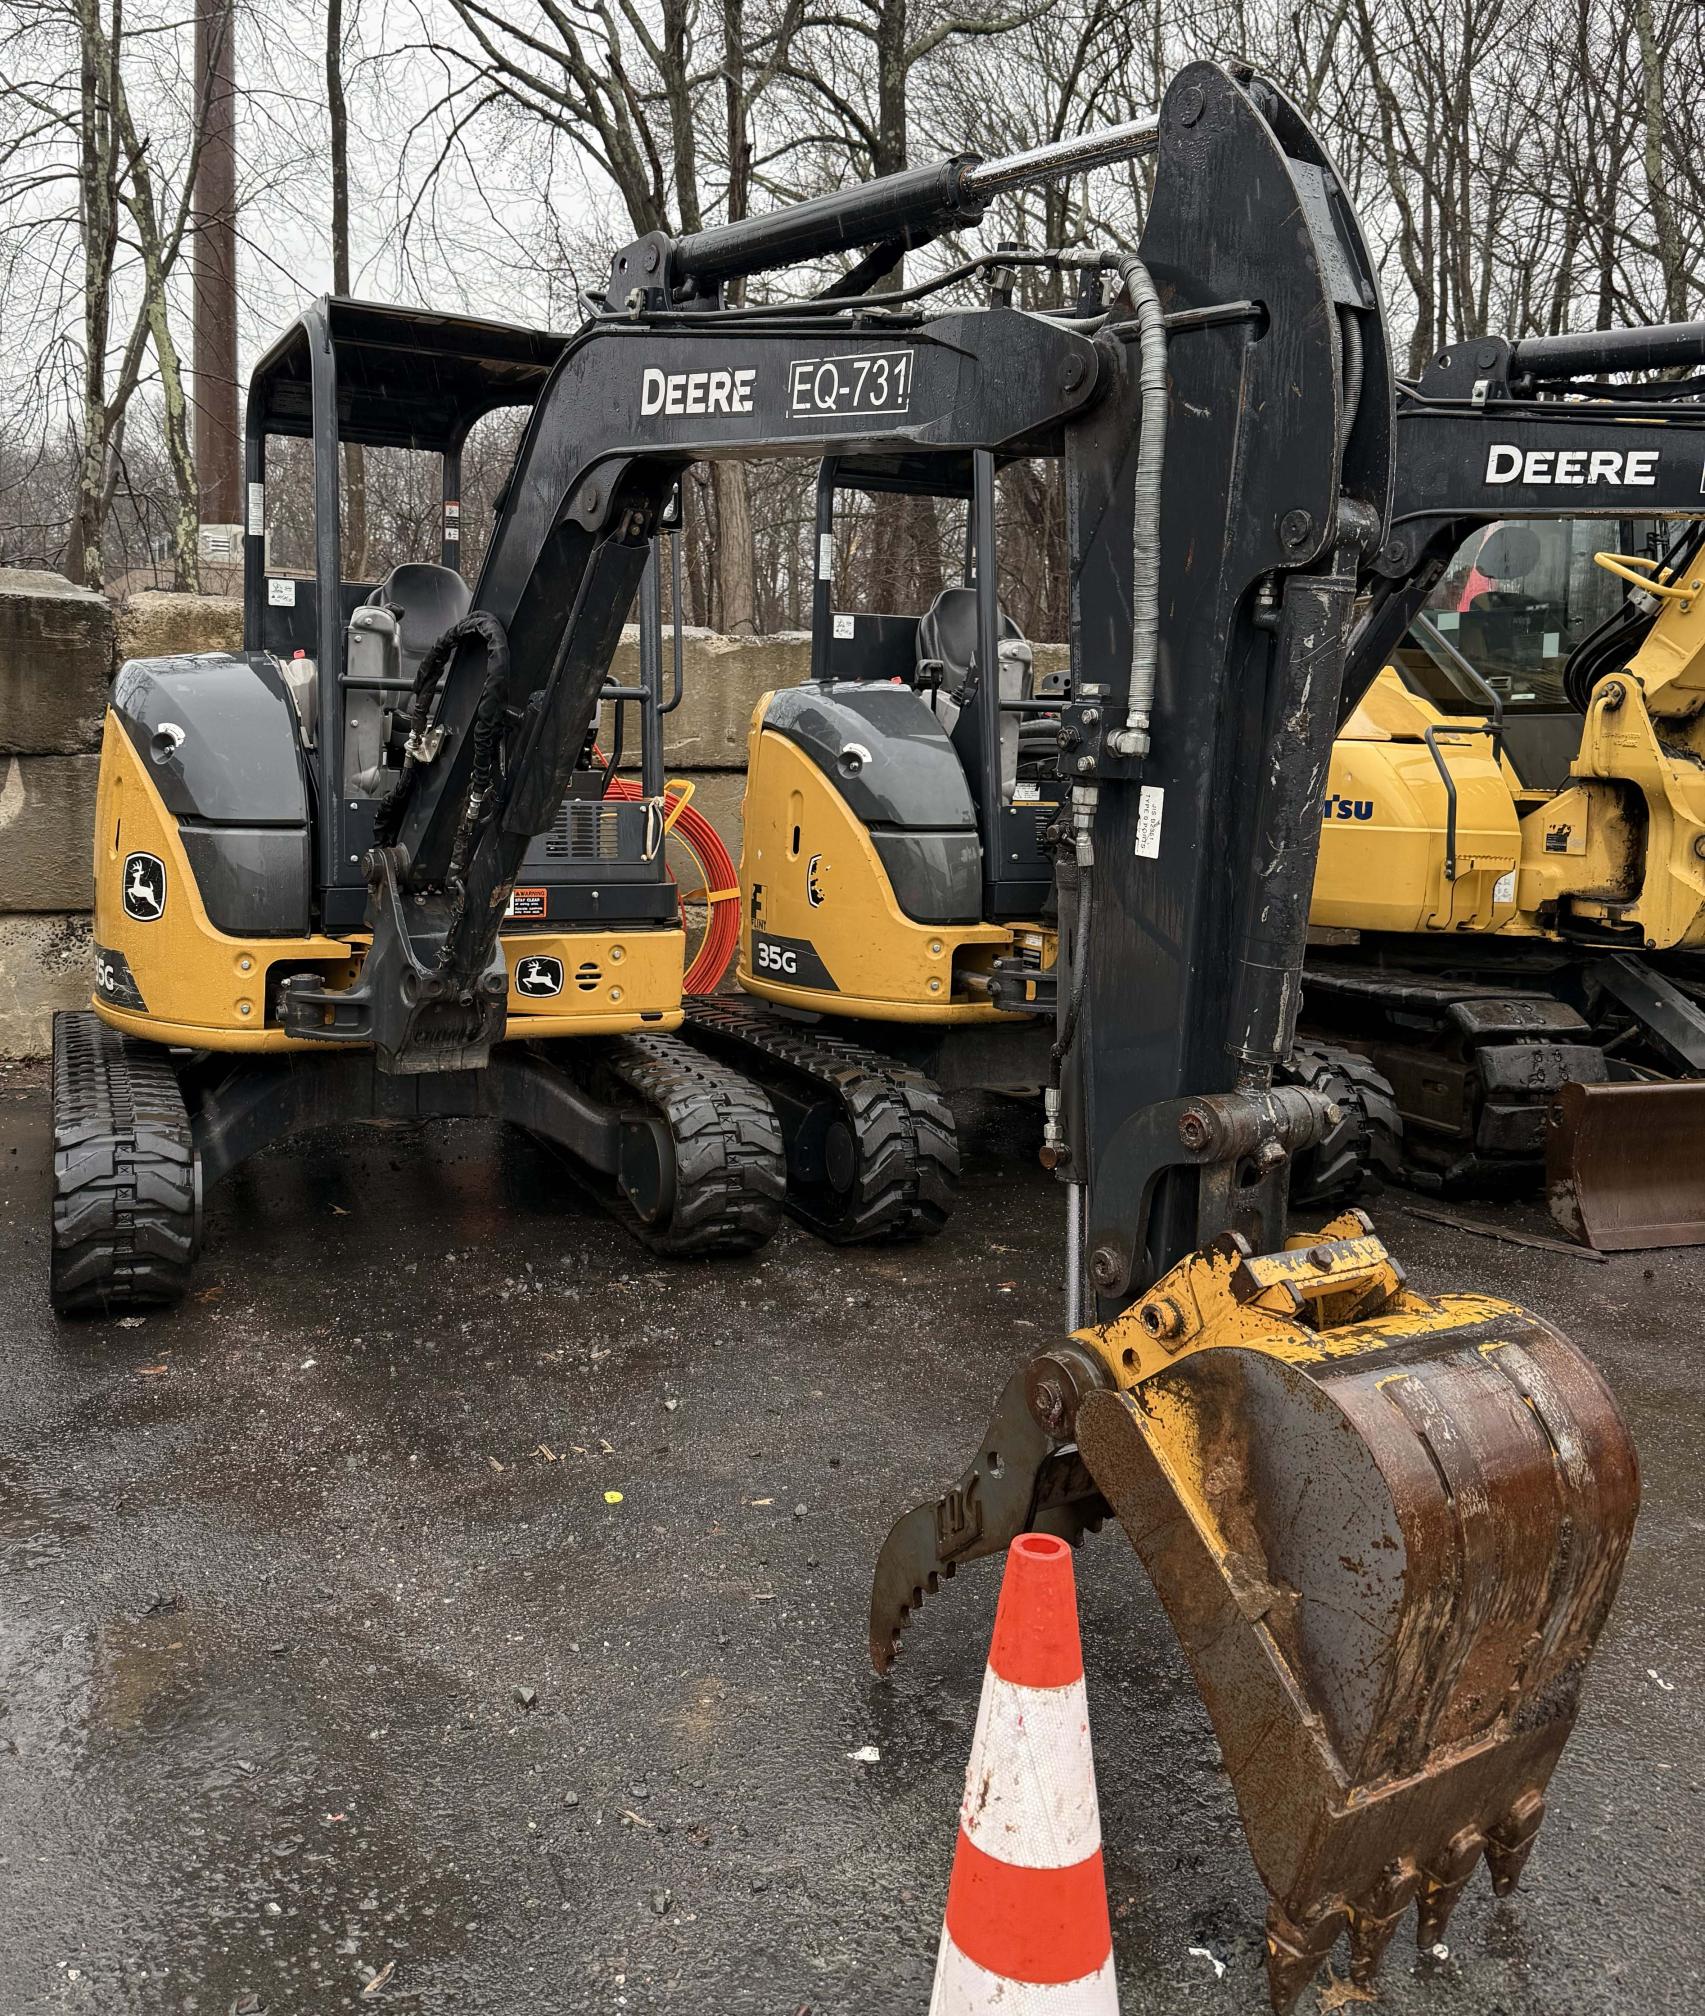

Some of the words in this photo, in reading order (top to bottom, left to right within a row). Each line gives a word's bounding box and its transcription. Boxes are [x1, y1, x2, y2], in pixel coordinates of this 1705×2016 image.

[641, 368, 756, 416] DEERE
[792, 357, 907, 410] EQ-731
[1485, 445, 1659, 485] DEERE
[1143, 794, 1151, 814] TYPE
[1324, 794, 1374, 820] TSU
[758, 942, 797, 974] 35G
